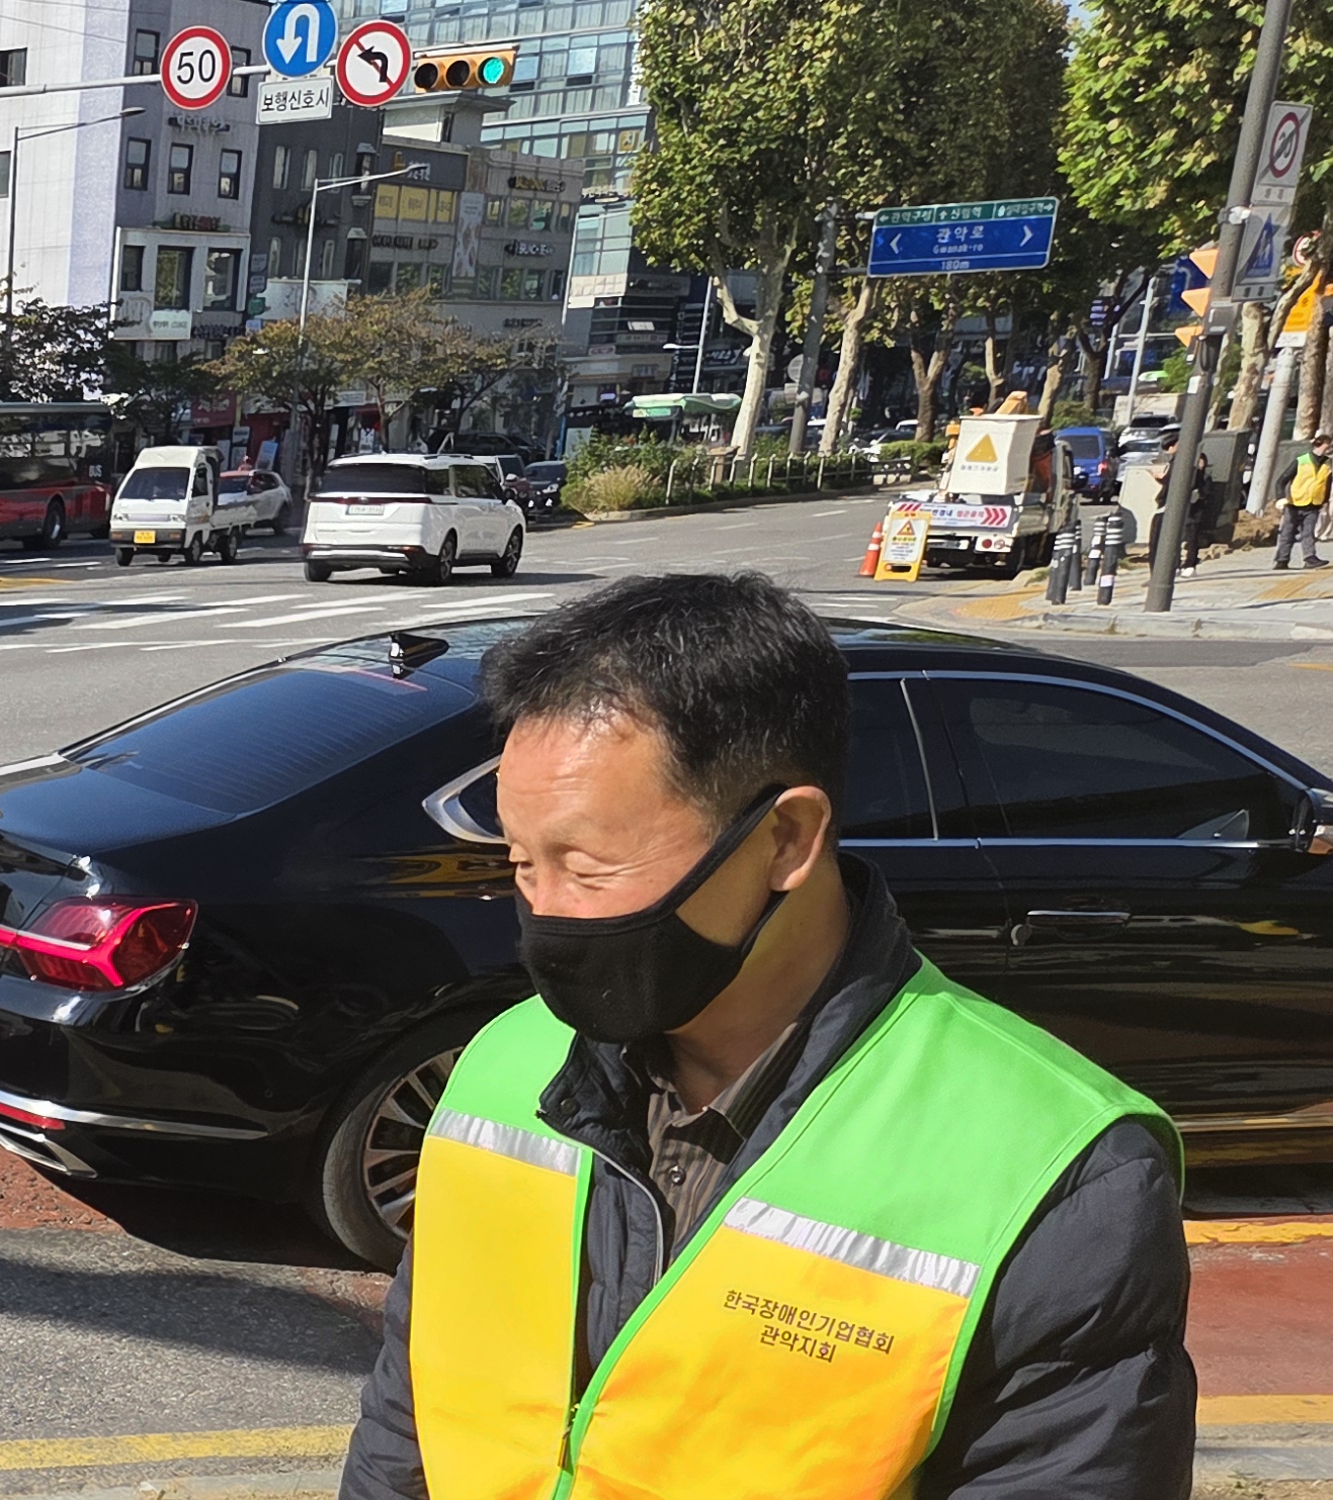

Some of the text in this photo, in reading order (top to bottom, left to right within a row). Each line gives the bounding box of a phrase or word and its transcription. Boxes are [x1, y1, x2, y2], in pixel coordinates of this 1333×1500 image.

[176, 49, 216, 84] 50
[261, 87, 329, 112] 보행신호시
[936, 226, 984, 243] 관악로
[941, 260, 970, 270] 180m
[723, 1289, 895, 1355] 한국장애인기업협회
[759, 1324, 837, 1363] 관악지회
